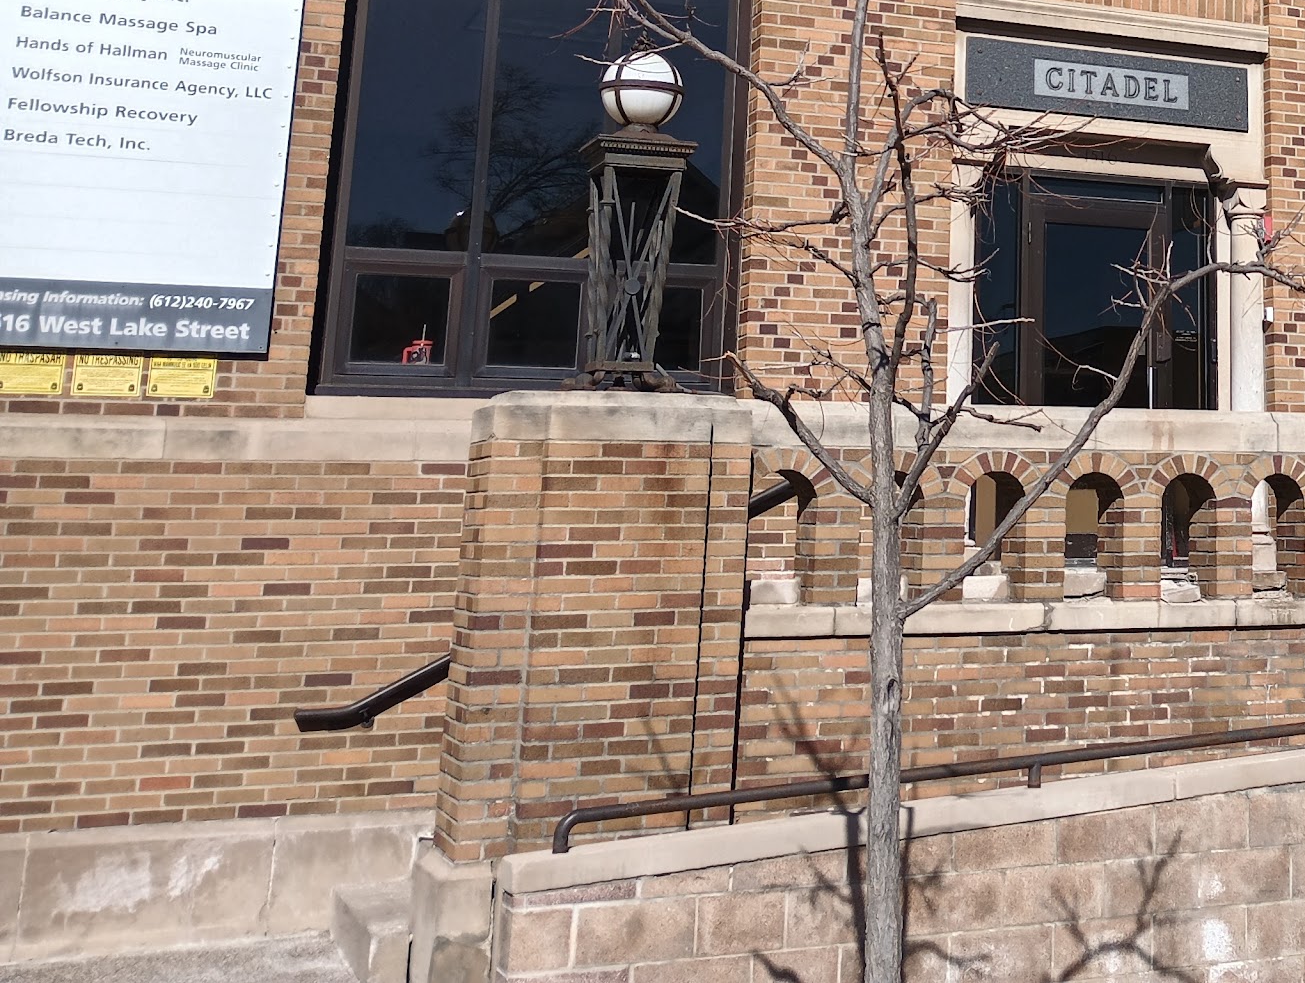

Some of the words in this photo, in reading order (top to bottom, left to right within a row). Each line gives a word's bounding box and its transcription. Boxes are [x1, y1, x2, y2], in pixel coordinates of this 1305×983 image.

[20, 6, 92, 23] Balance
[99, 14, 179, 33] Massage
[186, 21, 217, 36] Spa
[16, 36, 69, 52] Hands
[76, 42, 94, 54] of
[100, 44, 168, 61] Hallman
[180, 48, 262, 62] Neuromuscular
[179, 58, 226, 70] Massage
[230, 62, 259, 72] Clinic
[12, 67, 83, 83] Wolfson
[89, 73, 169, 90] Insurance
[175, 81, 239, 99] Agency,
[245, 87, 273, 100] LLC
[1045, 67, 1178, 104] CITADEL
[7, 97, 108, 118] Fellowship
[115, 106, 198, 125] Recovery
[3, 129, 58, 144] Breda
[66, 133, 112, 149] Tech,
[120, 137, 151, 151] Inc.
[43, 291, 144, 307] Information:
[149, 294, 255, 311] (612)240-7967
[0, 314, 31, 332] 16
[39, 315, 103, 335] West
[110, 318, 167, 337] Lake
[175, 320, 250, 340] Street
[92, 355, 139, 365] TRESPASSING
